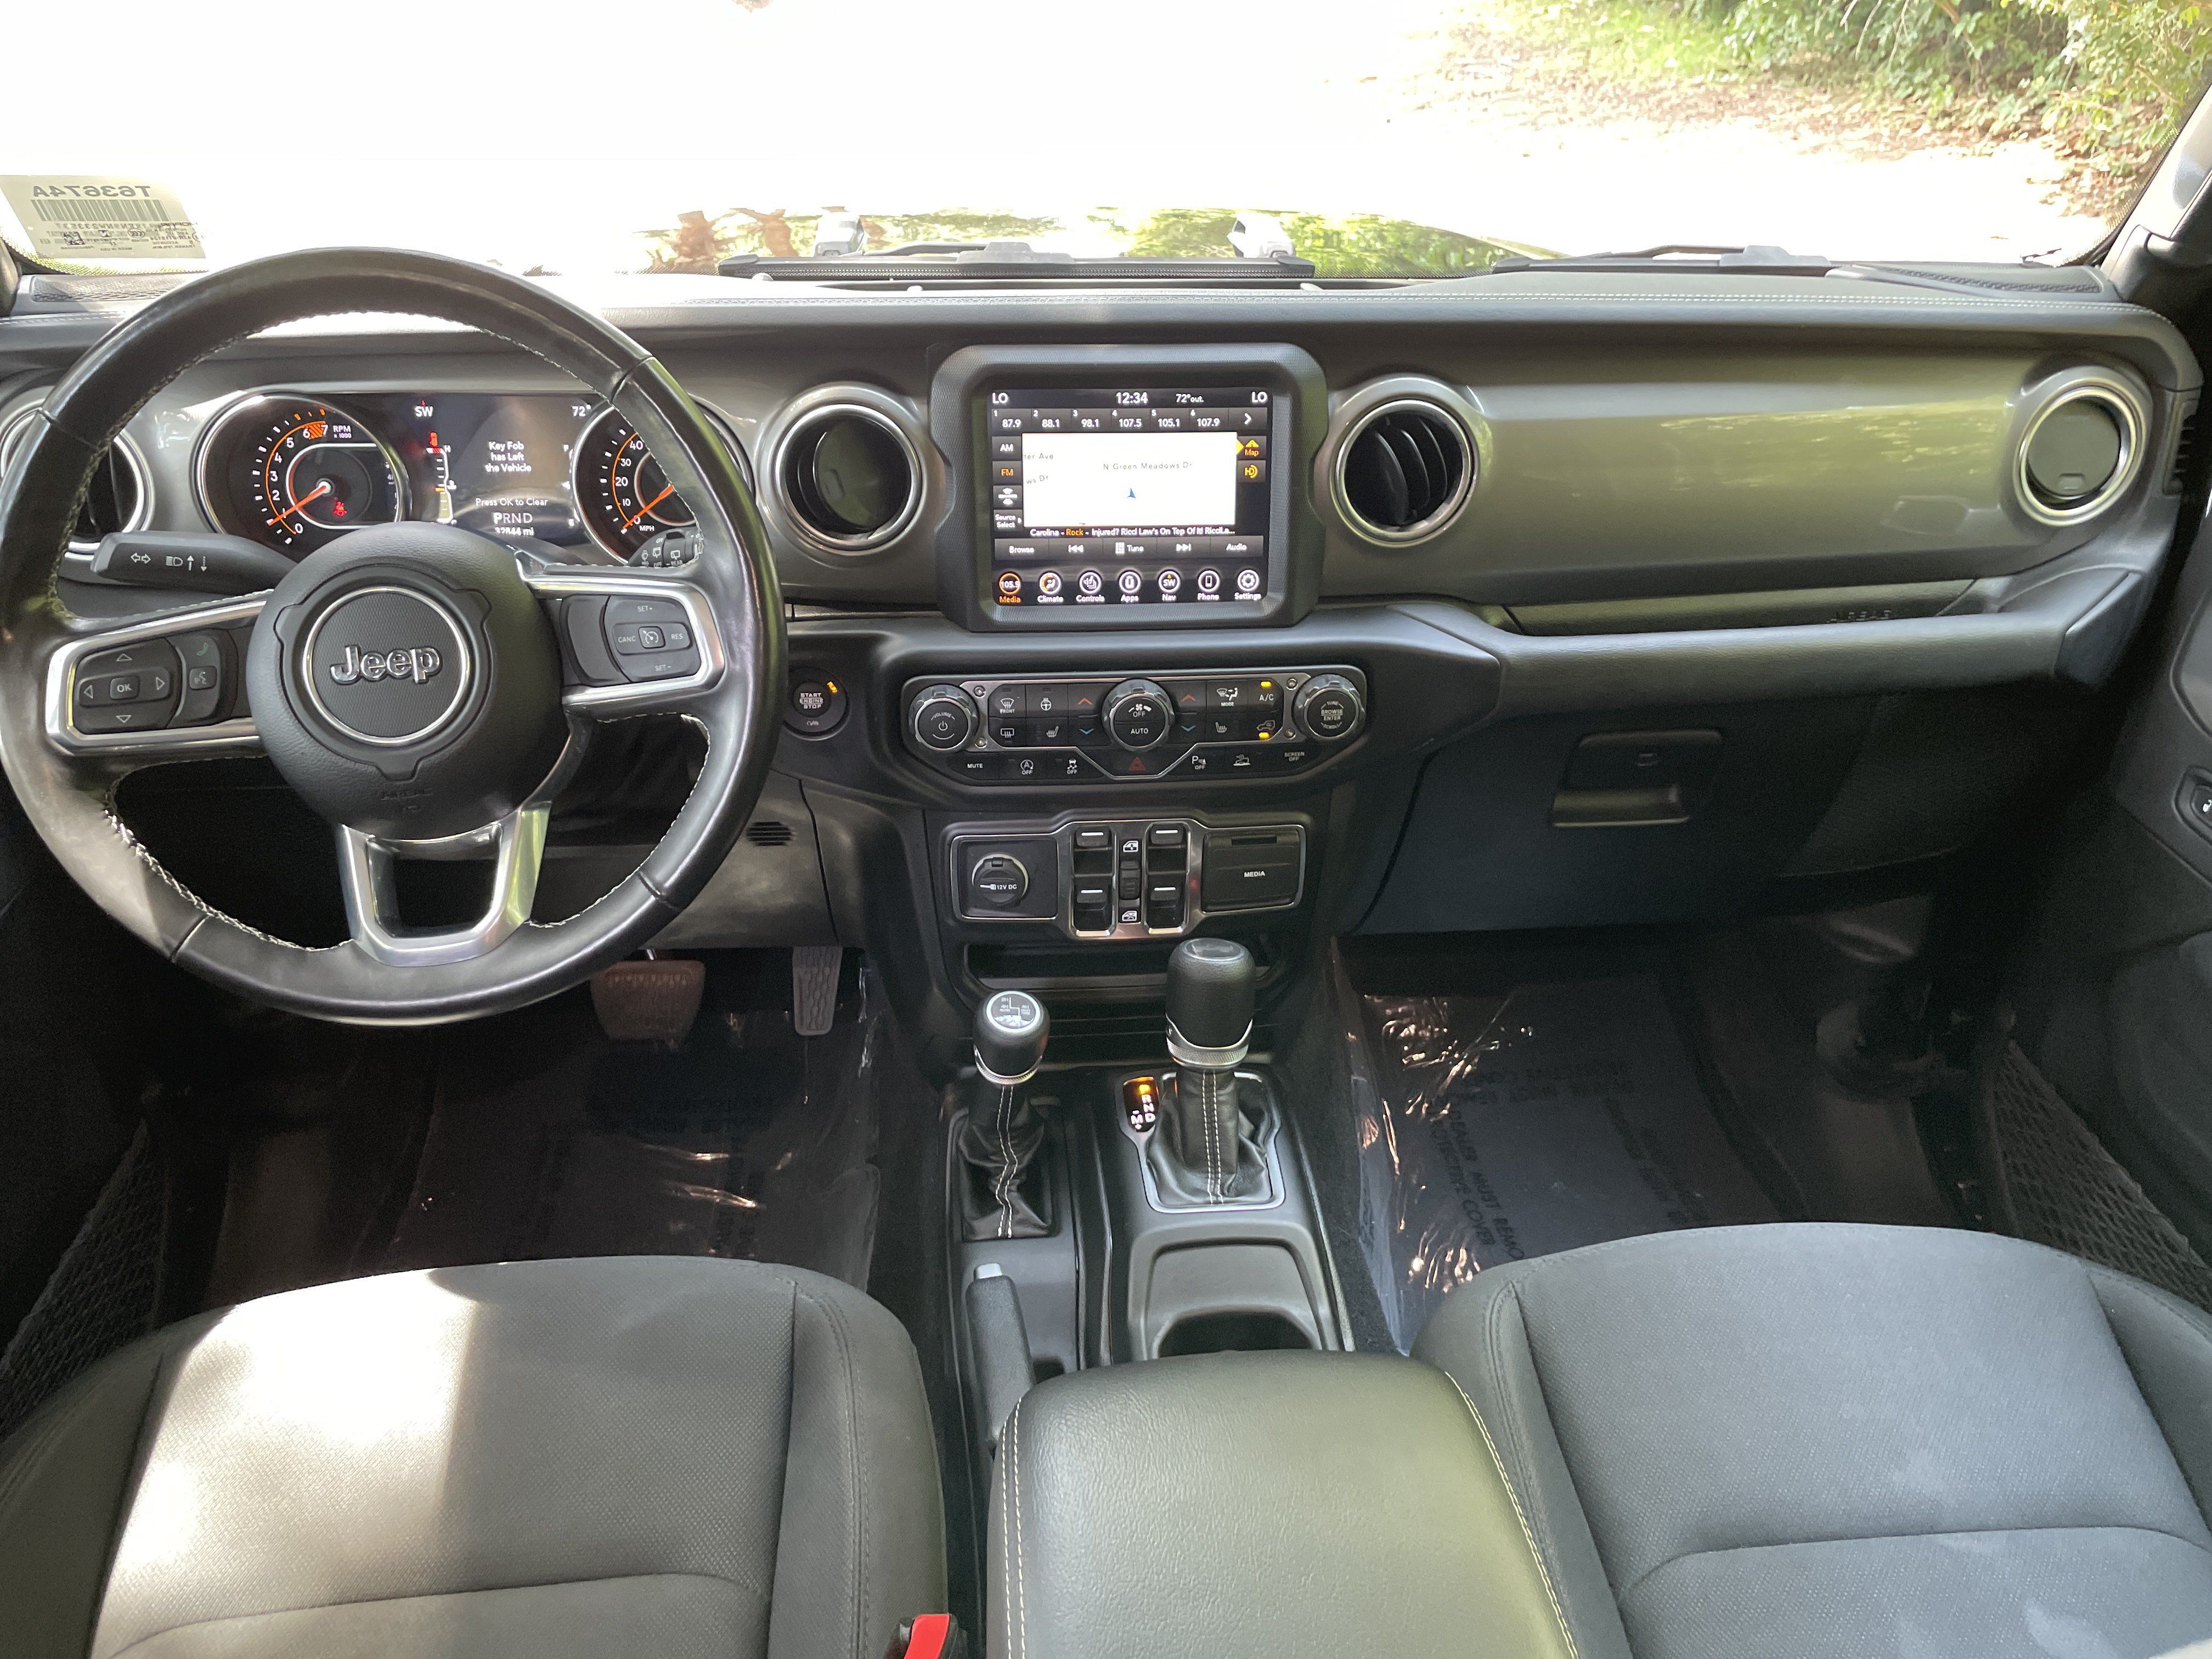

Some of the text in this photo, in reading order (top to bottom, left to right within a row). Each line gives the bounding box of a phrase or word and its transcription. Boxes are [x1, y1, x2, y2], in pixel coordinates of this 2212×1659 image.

[992, 392, 1008, 404] LO
[1116, 392, 1148, 404] 12:34
[1251, 392, 1267, 403] LO
[414, 405, 433, 417] SW
[1002, 419, 1021, 427] 87.9
[1042, 419, 1060, 427] 88.1
[1081, 419, 1099, 427] 98.1
[1119, 419, 1142, 427] 107.5
[1158, 419, 1180, 427] 105.1
[1197, 418, 1220, 427] 107.9
[303, 428, 310, 439] 6
[321, 425, 329, 436] 7
[286, 437, 295, 448] 5
[489, 441, 524, 452] Key Fob
[629, 441, 643, 450] 40
[274, 453, 282, 464] 4
[491, 452, 524, 461] has Left
[485, 463, 532, 472] the Vehicle
[270, 471, 278, 482] 3
[616, 477, 628, 486] 20
[272, 489, 280, 500] 2
[499, 498, 514, 506] OK
[526, 498, 548, 506] Clear
[295, 523, 303, 533] 0
[1172, 527, 1185, 536] Top
[1120, 594, 1138, 603] Apps
[1234, 592, 1261, 601] Settings
[330, 645, 443, 685] Jeep
[117, 684, 132, 692] OK
[1143, 1103, 1154, 1113] N
[1145, 1113, 1156, 1122] D
[1462, 1199, 1496, 1246] COVER
[1492, 1217, 1526, 1260] REMO
